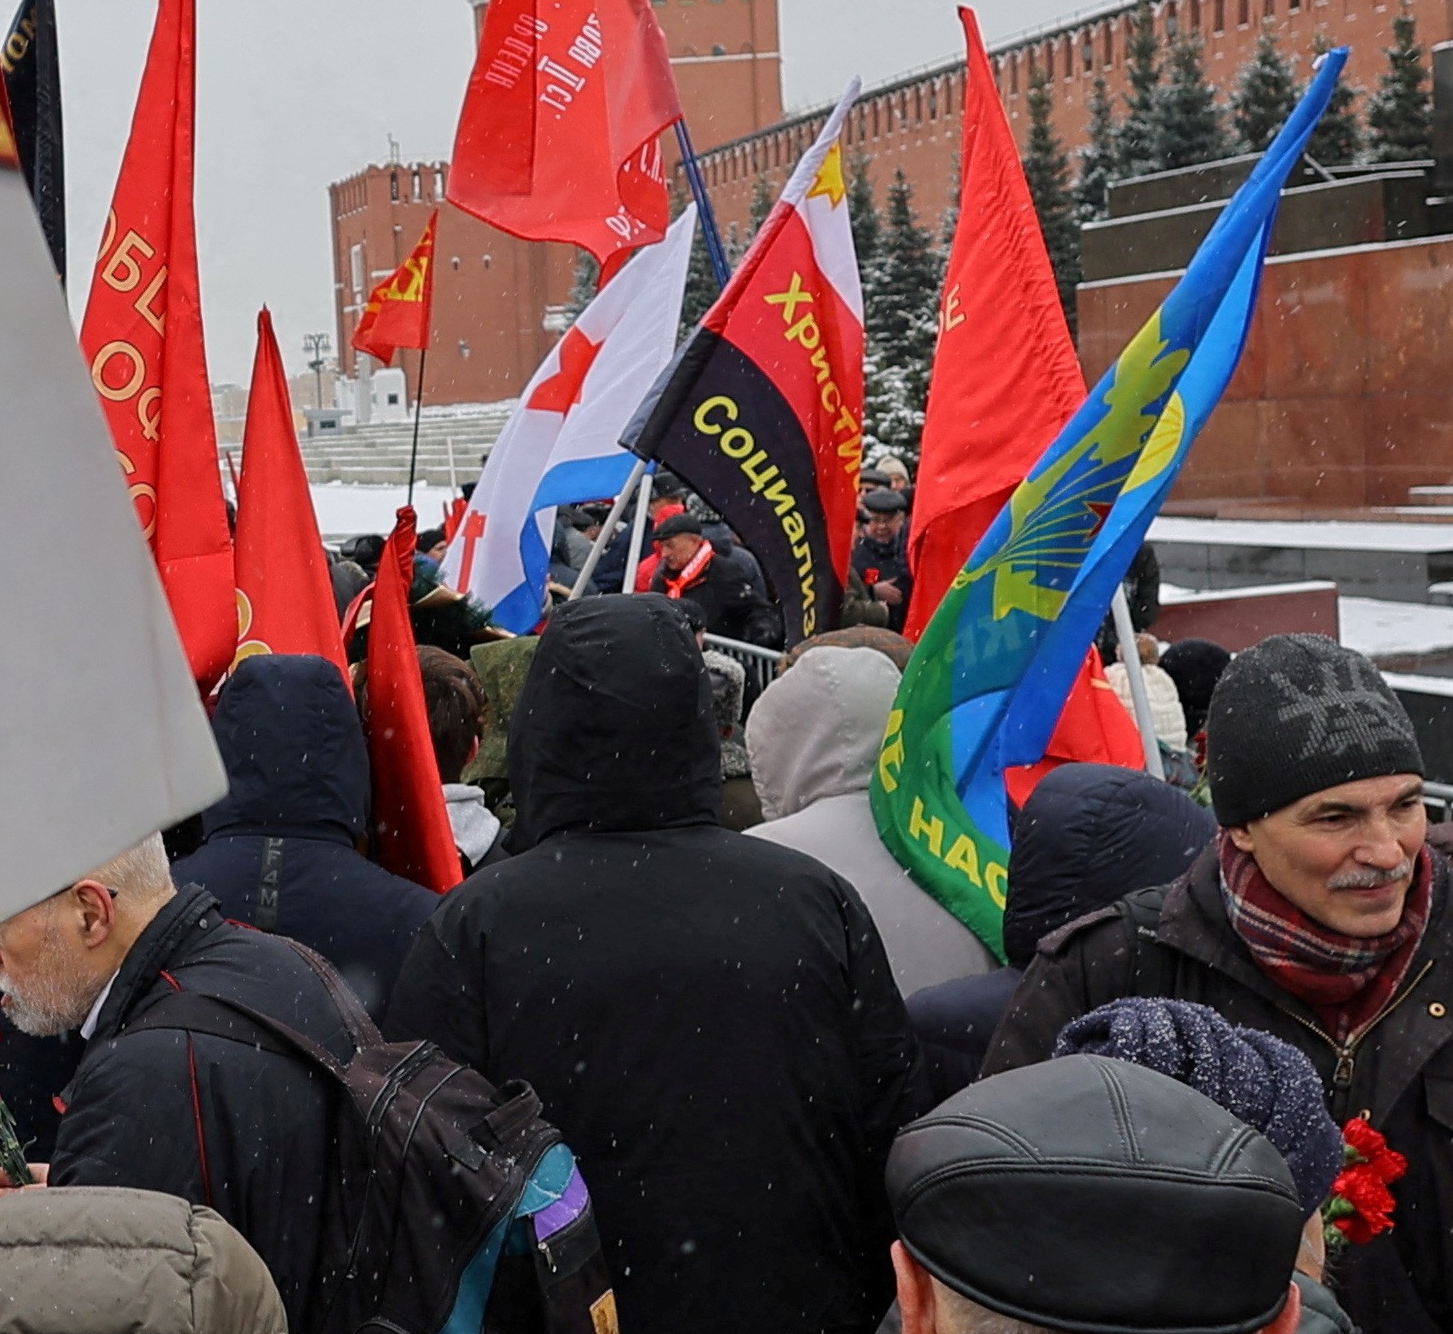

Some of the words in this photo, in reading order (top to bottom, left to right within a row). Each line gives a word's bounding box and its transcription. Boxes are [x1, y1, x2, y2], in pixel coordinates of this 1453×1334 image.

[763, 270, 861, 491] Христи
[694, 395, 818, 638] Социализ
[908, 795, 1009, 910] НАС
